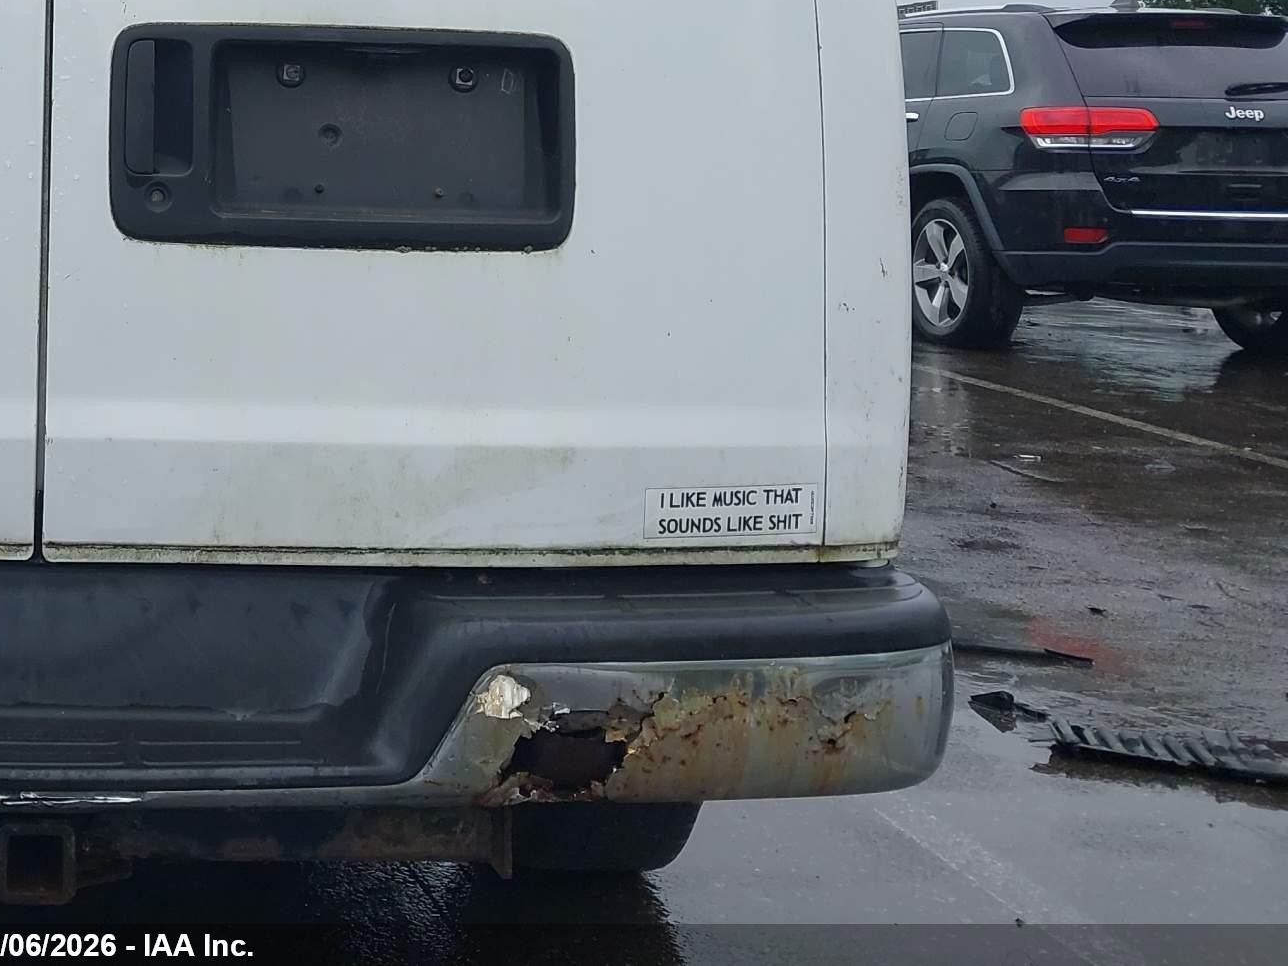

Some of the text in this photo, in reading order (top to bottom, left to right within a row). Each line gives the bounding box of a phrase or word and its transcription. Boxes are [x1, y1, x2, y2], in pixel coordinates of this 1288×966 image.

[1225, 106, 1264, 122] Jeep
[661, 488, 802, 508] I LIKE MUSIC THAT
[658, 514, 802, 534] SOUNDS LIKE SHIT
